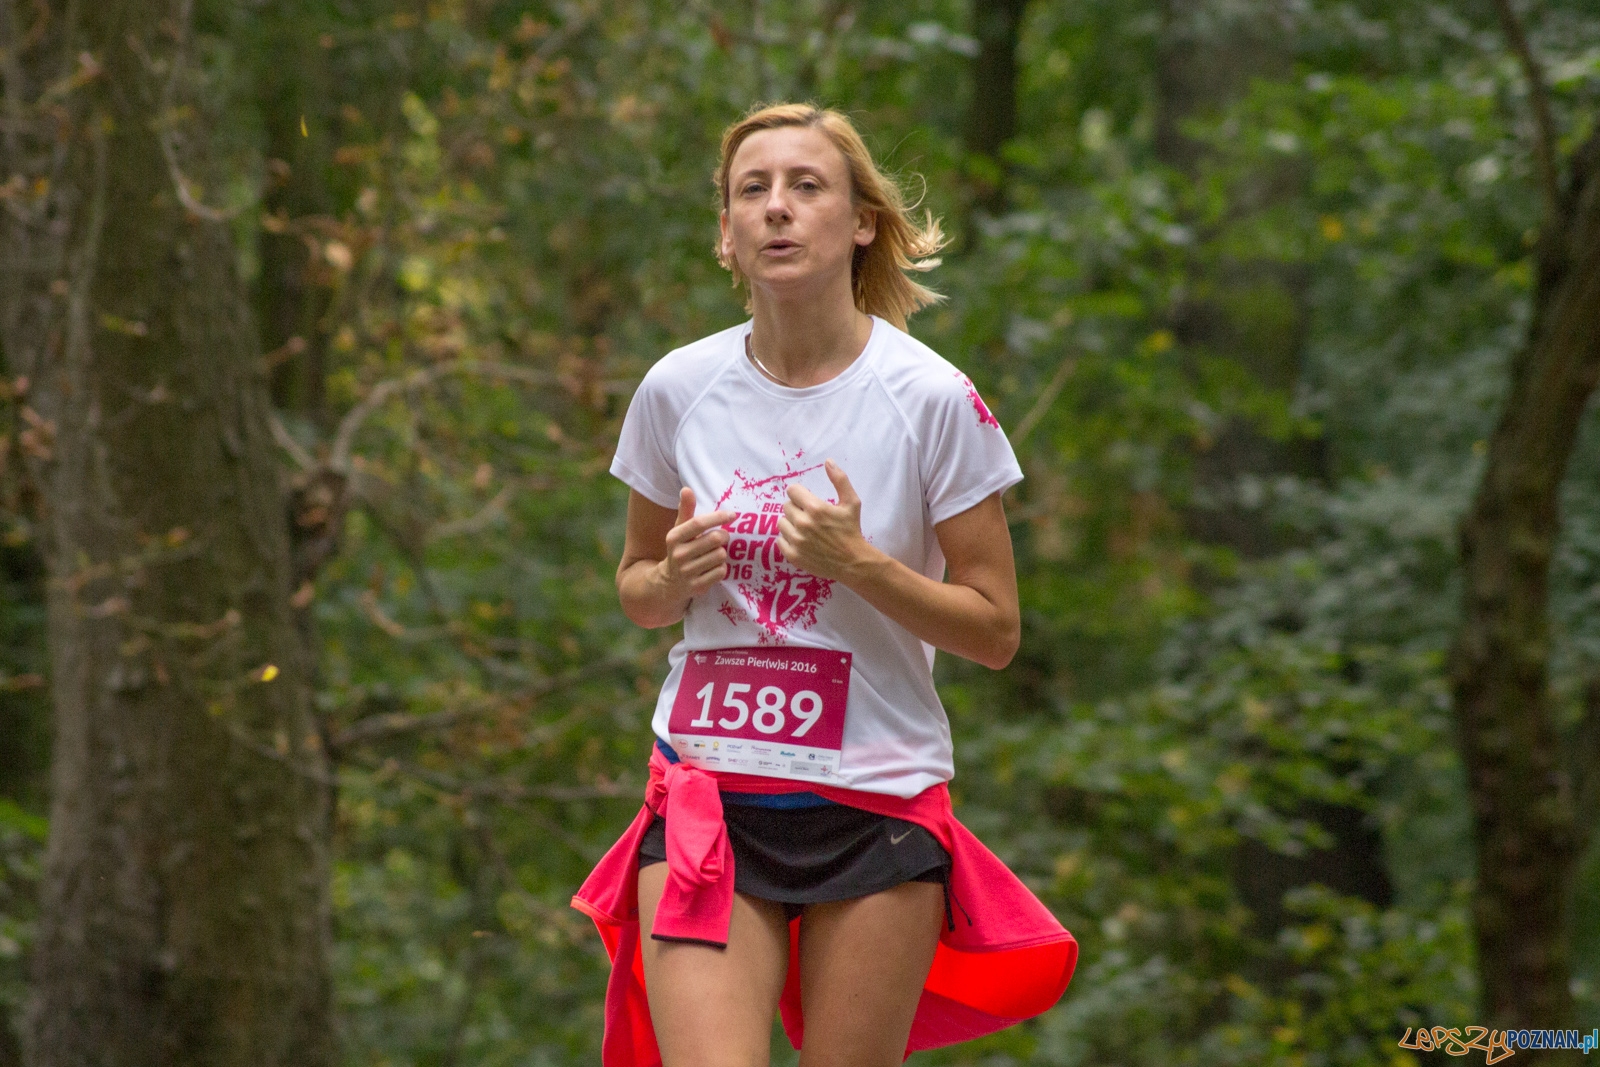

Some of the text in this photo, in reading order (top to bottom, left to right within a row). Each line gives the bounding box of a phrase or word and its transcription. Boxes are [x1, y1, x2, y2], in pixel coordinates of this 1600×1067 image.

[714, 655, 746, 666] Zawsze
[747, 656, 789, 671] Pier(w)si
[790, 661, 818, 674] 2016
[690, 681, 823, 738] 1589
